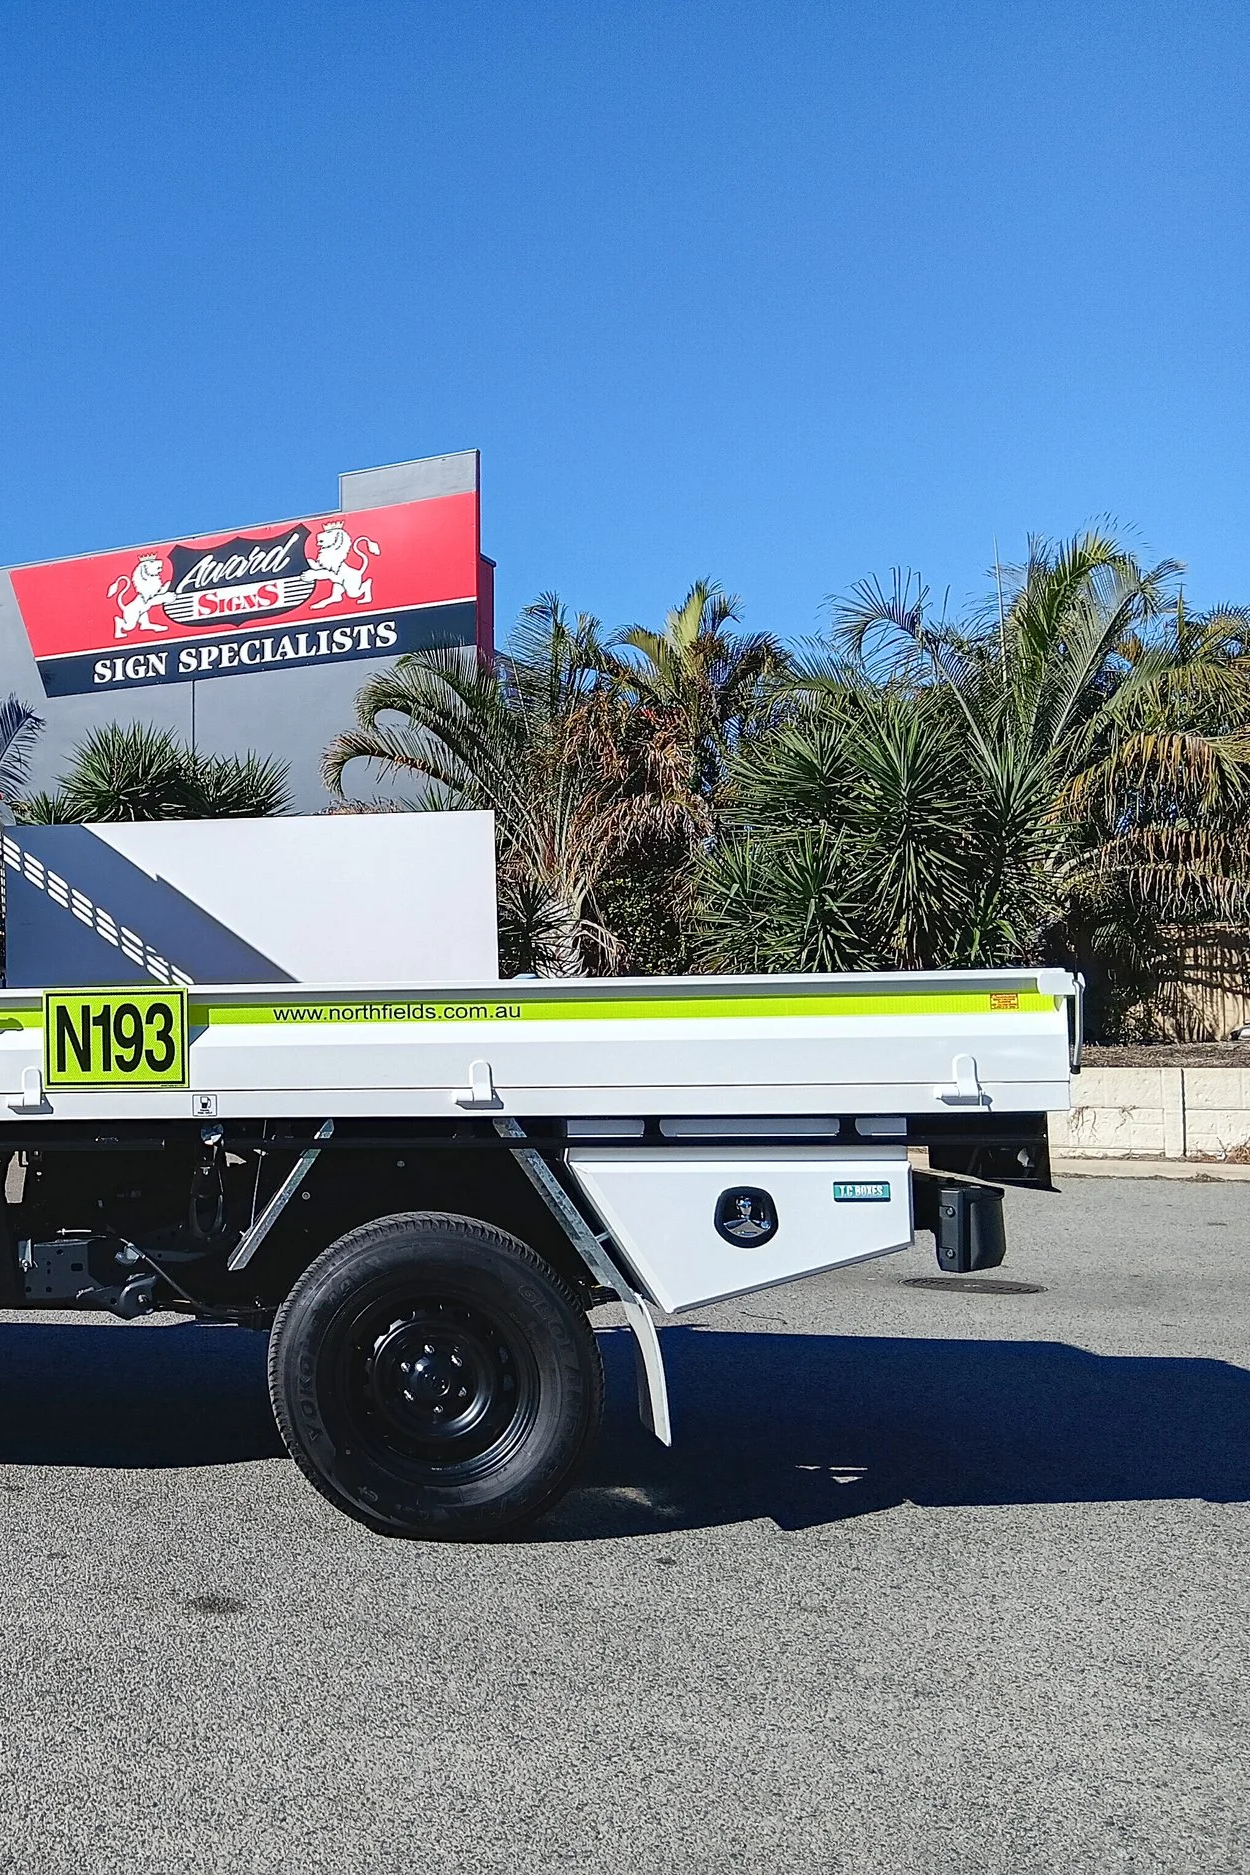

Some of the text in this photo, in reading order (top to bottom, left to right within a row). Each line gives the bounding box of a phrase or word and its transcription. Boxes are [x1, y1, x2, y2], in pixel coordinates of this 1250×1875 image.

[176, 532, 299, 594] Award
[197, 581, 280, 616] SIGNS
[93, 621, 398, 684] SIGN SPECIALISTS
[273, 1003, 522, 1021] www.northfields.com.au
[56, 1002, 176, 1073] N193
[855, 1184, 883, 1197] BOXES
